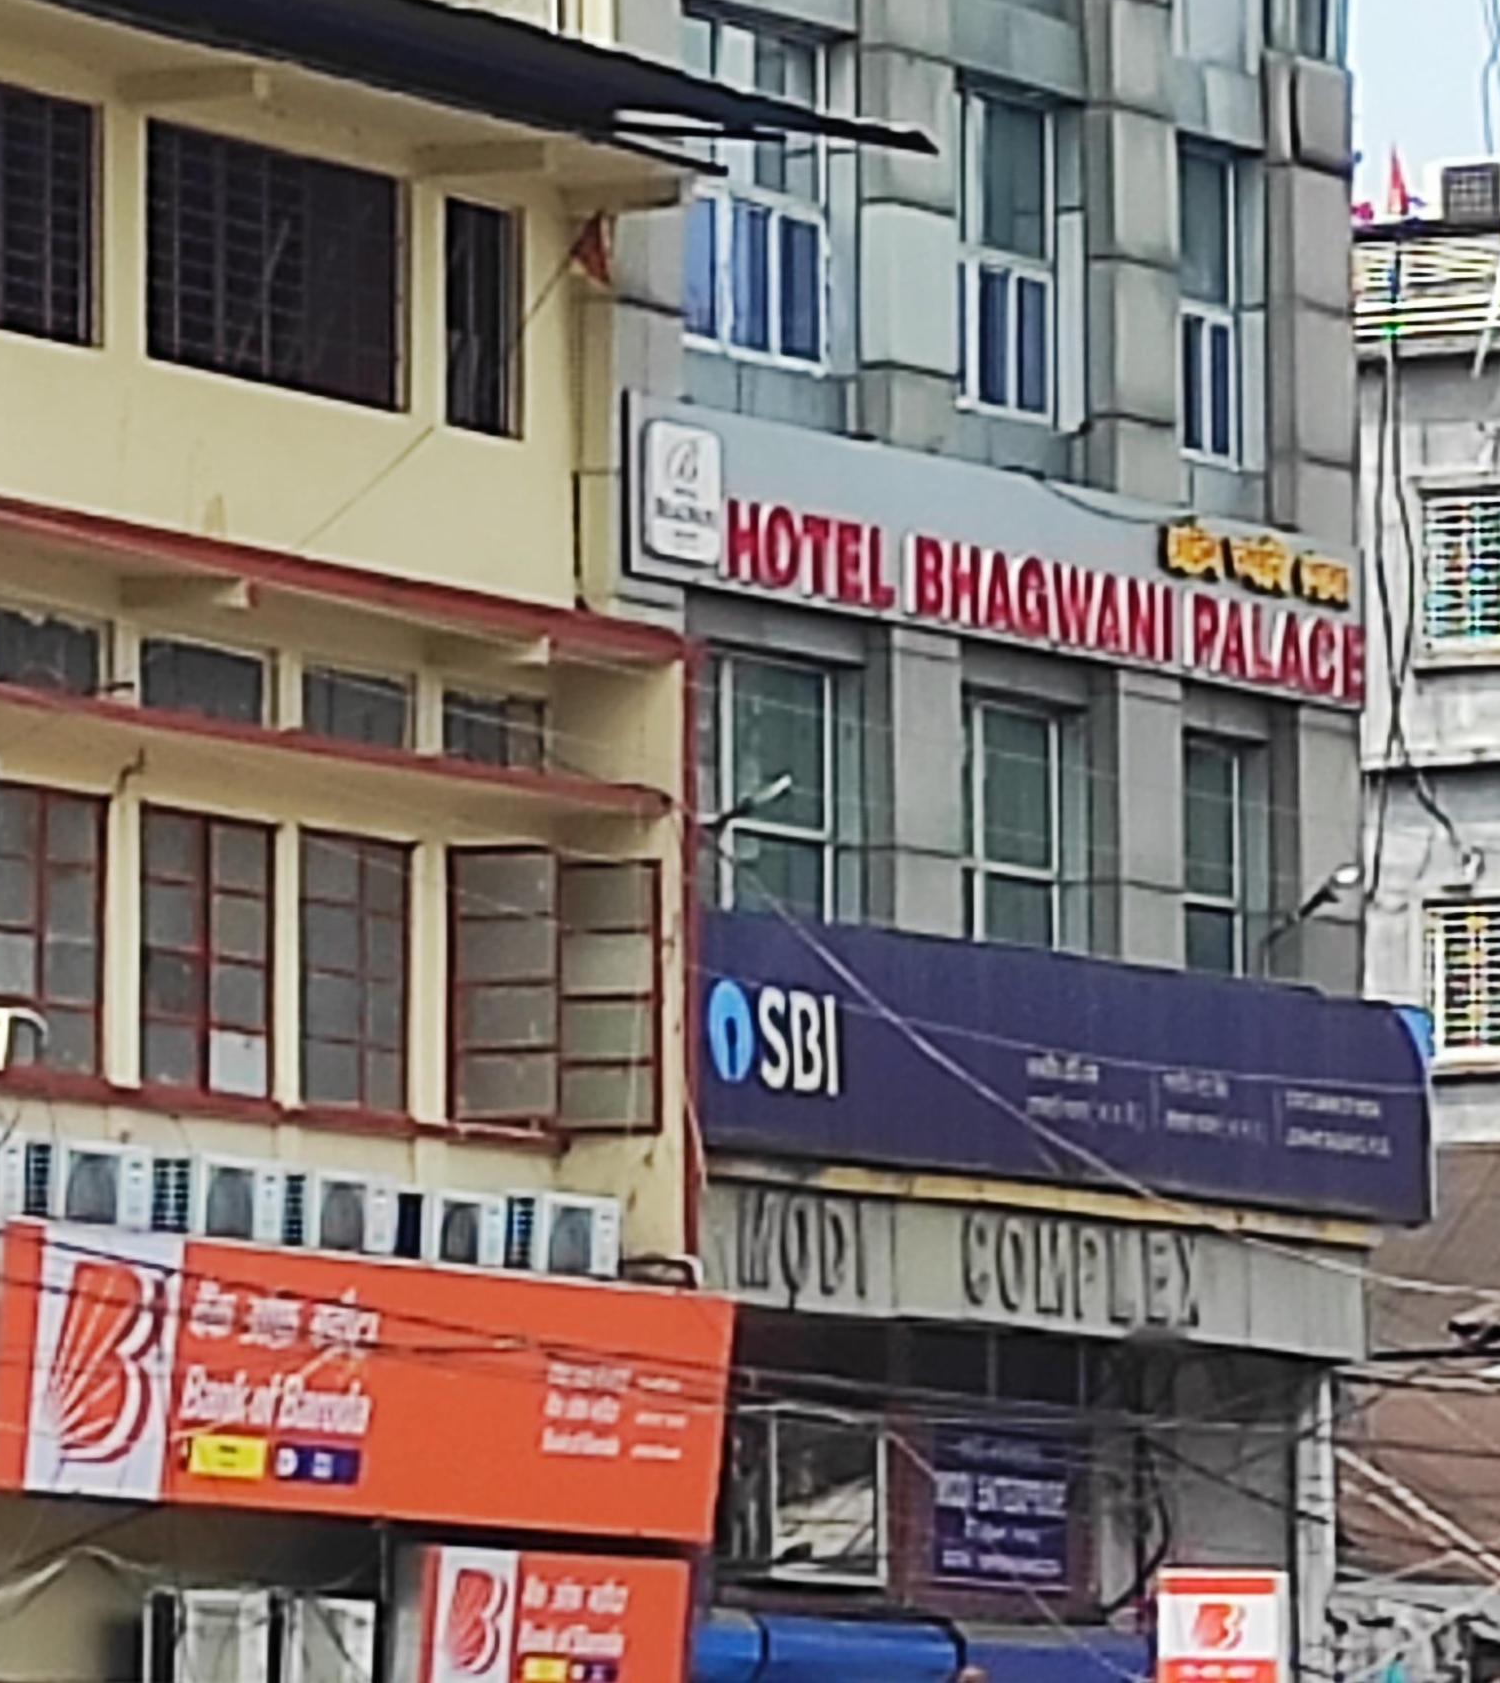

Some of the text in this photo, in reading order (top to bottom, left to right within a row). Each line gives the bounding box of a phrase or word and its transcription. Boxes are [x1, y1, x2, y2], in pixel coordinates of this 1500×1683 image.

[722, 498, 895, 612] HOTEL
[905, 532, 1174, 665] BHAGWANI
[1184, 592, 1366, 703] PALACE
[757, 984, 841, 1096] SBI
[735, 1188, 1201, 1328] MODI COMPLEX
[179, 1364, 250, 1425] Bank
